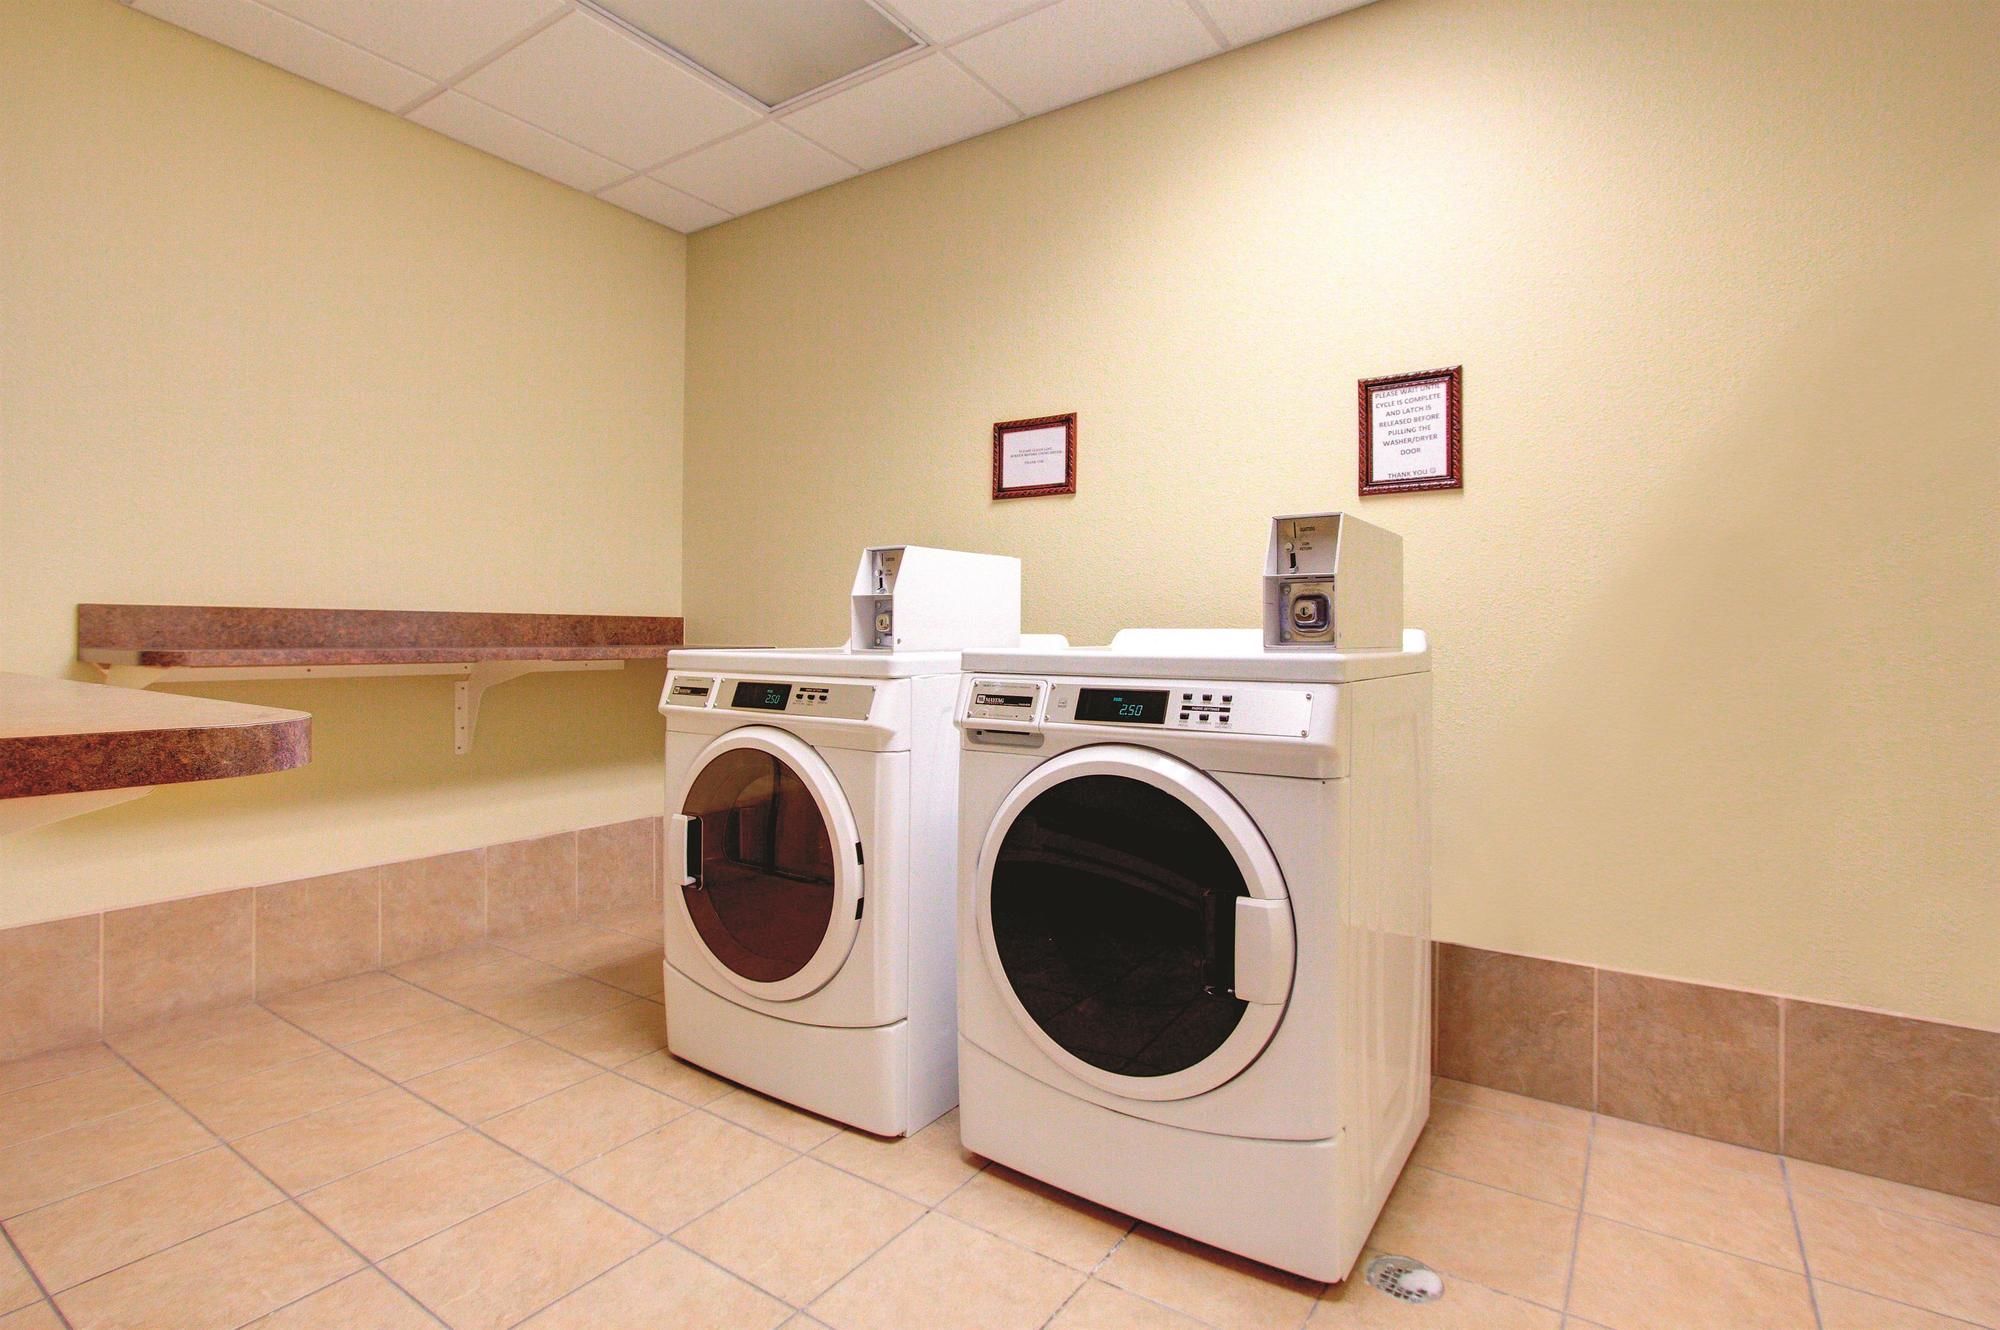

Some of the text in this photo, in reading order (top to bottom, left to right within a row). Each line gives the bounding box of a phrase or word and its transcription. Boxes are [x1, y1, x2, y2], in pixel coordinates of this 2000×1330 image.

[1375, 390, 1398, 399] PLEASE
[1400, 387, 1418, 395] WAIT
[1376, 400, 1395, 408] CYCLE
[1404, 393, 1441, 404] COMPLETE
[1402, 406, 1424, 414] LATCH
[1379, 413, 1440, 428] RELEASED BEFORE
[1388, 426, 1417, 436] PULLING
[1382, 434, 1438, 446] WASHER/DRYER
[1119, 704, 1143, 716] 2.50
